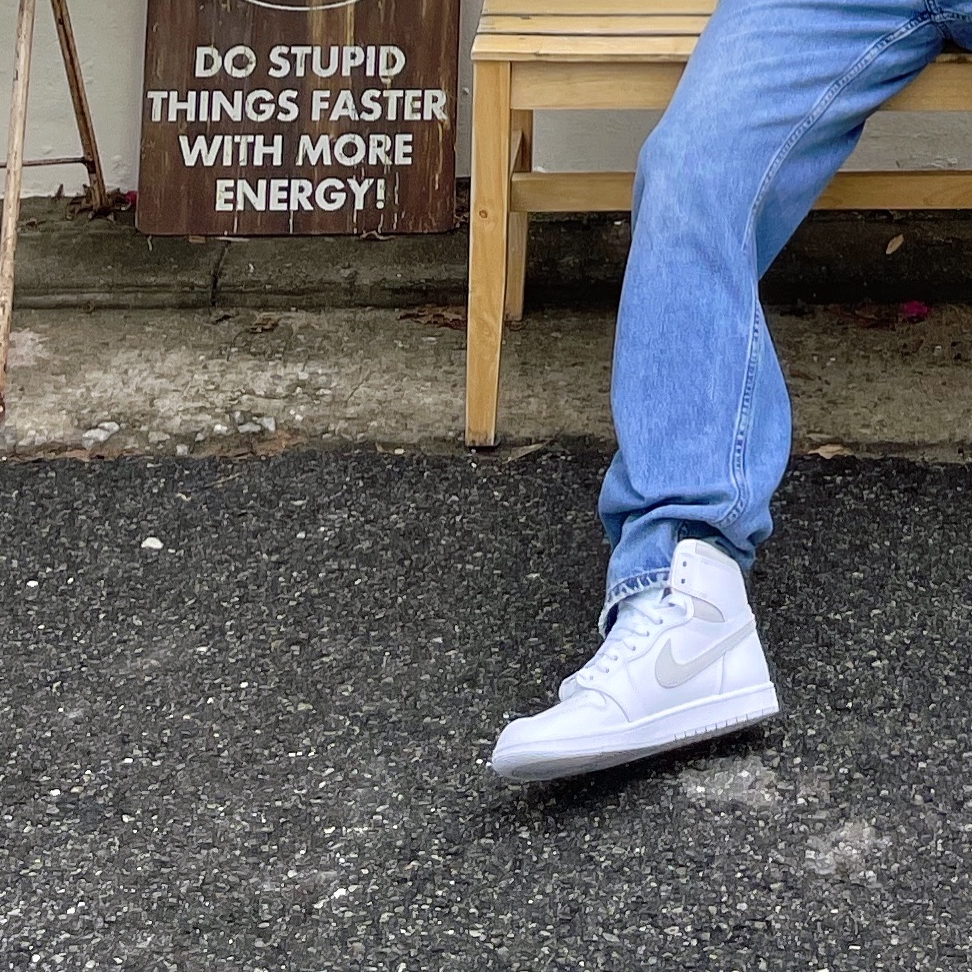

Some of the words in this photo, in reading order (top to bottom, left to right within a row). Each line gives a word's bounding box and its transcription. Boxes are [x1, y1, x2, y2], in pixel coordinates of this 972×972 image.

[195, 46, 257, 78] DO
[267, 45, 406, 78] STUPID
[147, 89, 299, 122] THINGS
[311, 89, 448, 121] FASTER
[179, 134, 293, 167] WITH
[296, 133, 413, 166] MORE
[215, 178, 386, 211] ENERGY!
